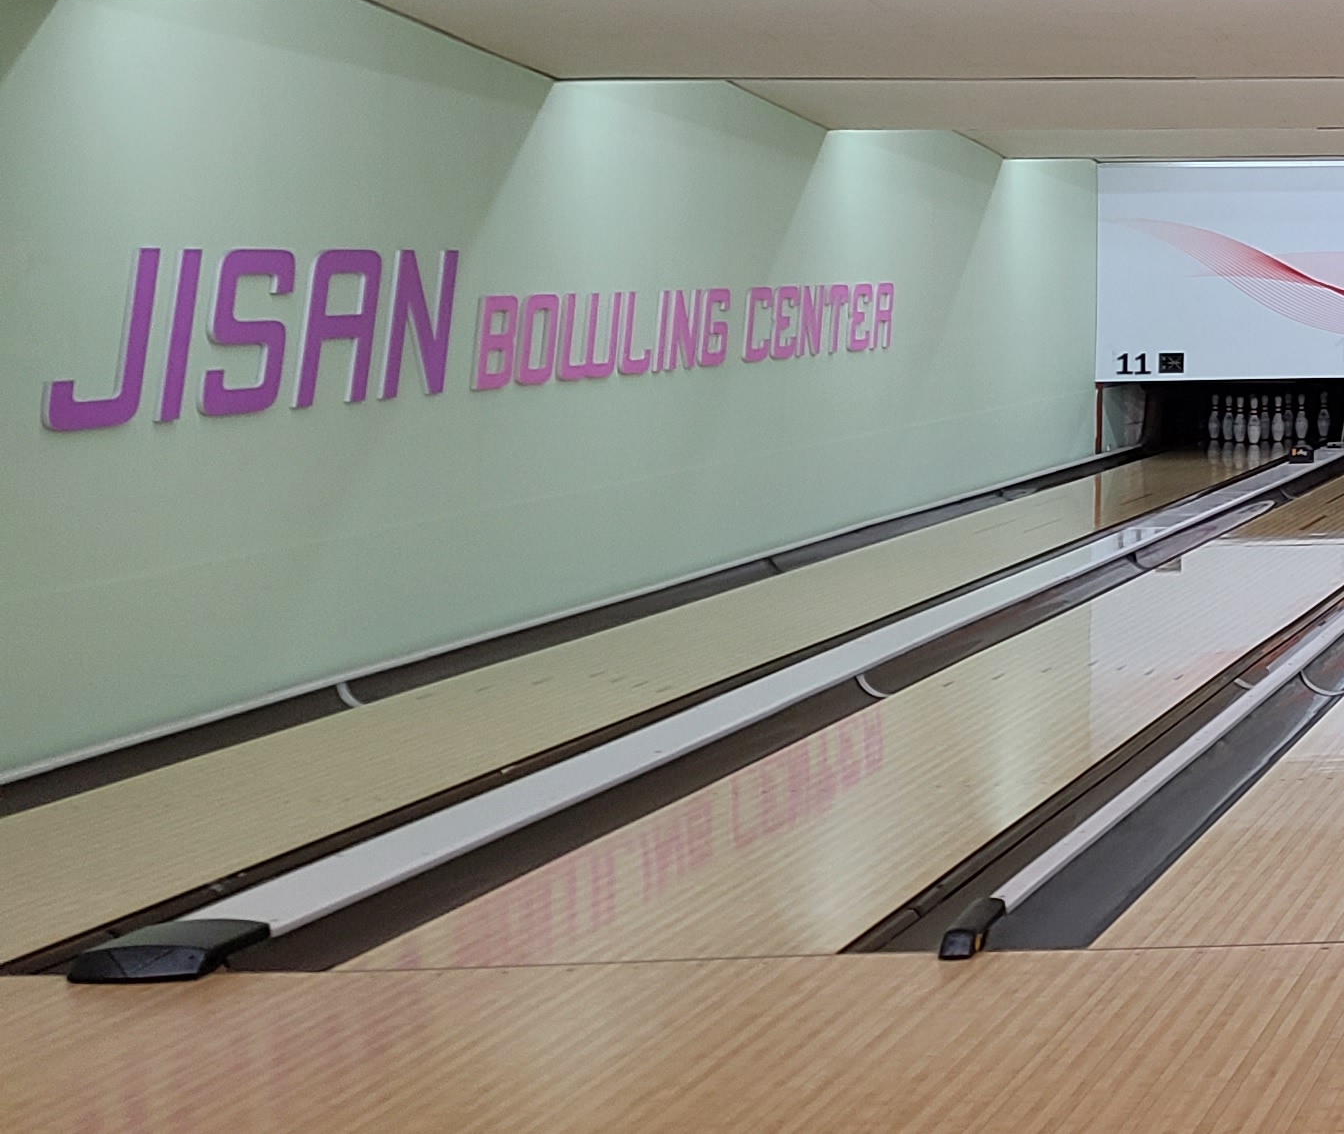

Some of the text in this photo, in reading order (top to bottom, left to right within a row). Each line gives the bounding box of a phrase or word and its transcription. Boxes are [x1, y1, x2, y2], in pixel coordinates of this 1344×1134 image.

[40, 248, 895, 432] JISAN BOWLING CENTER
[1115, 352, 1152, 375] 11
